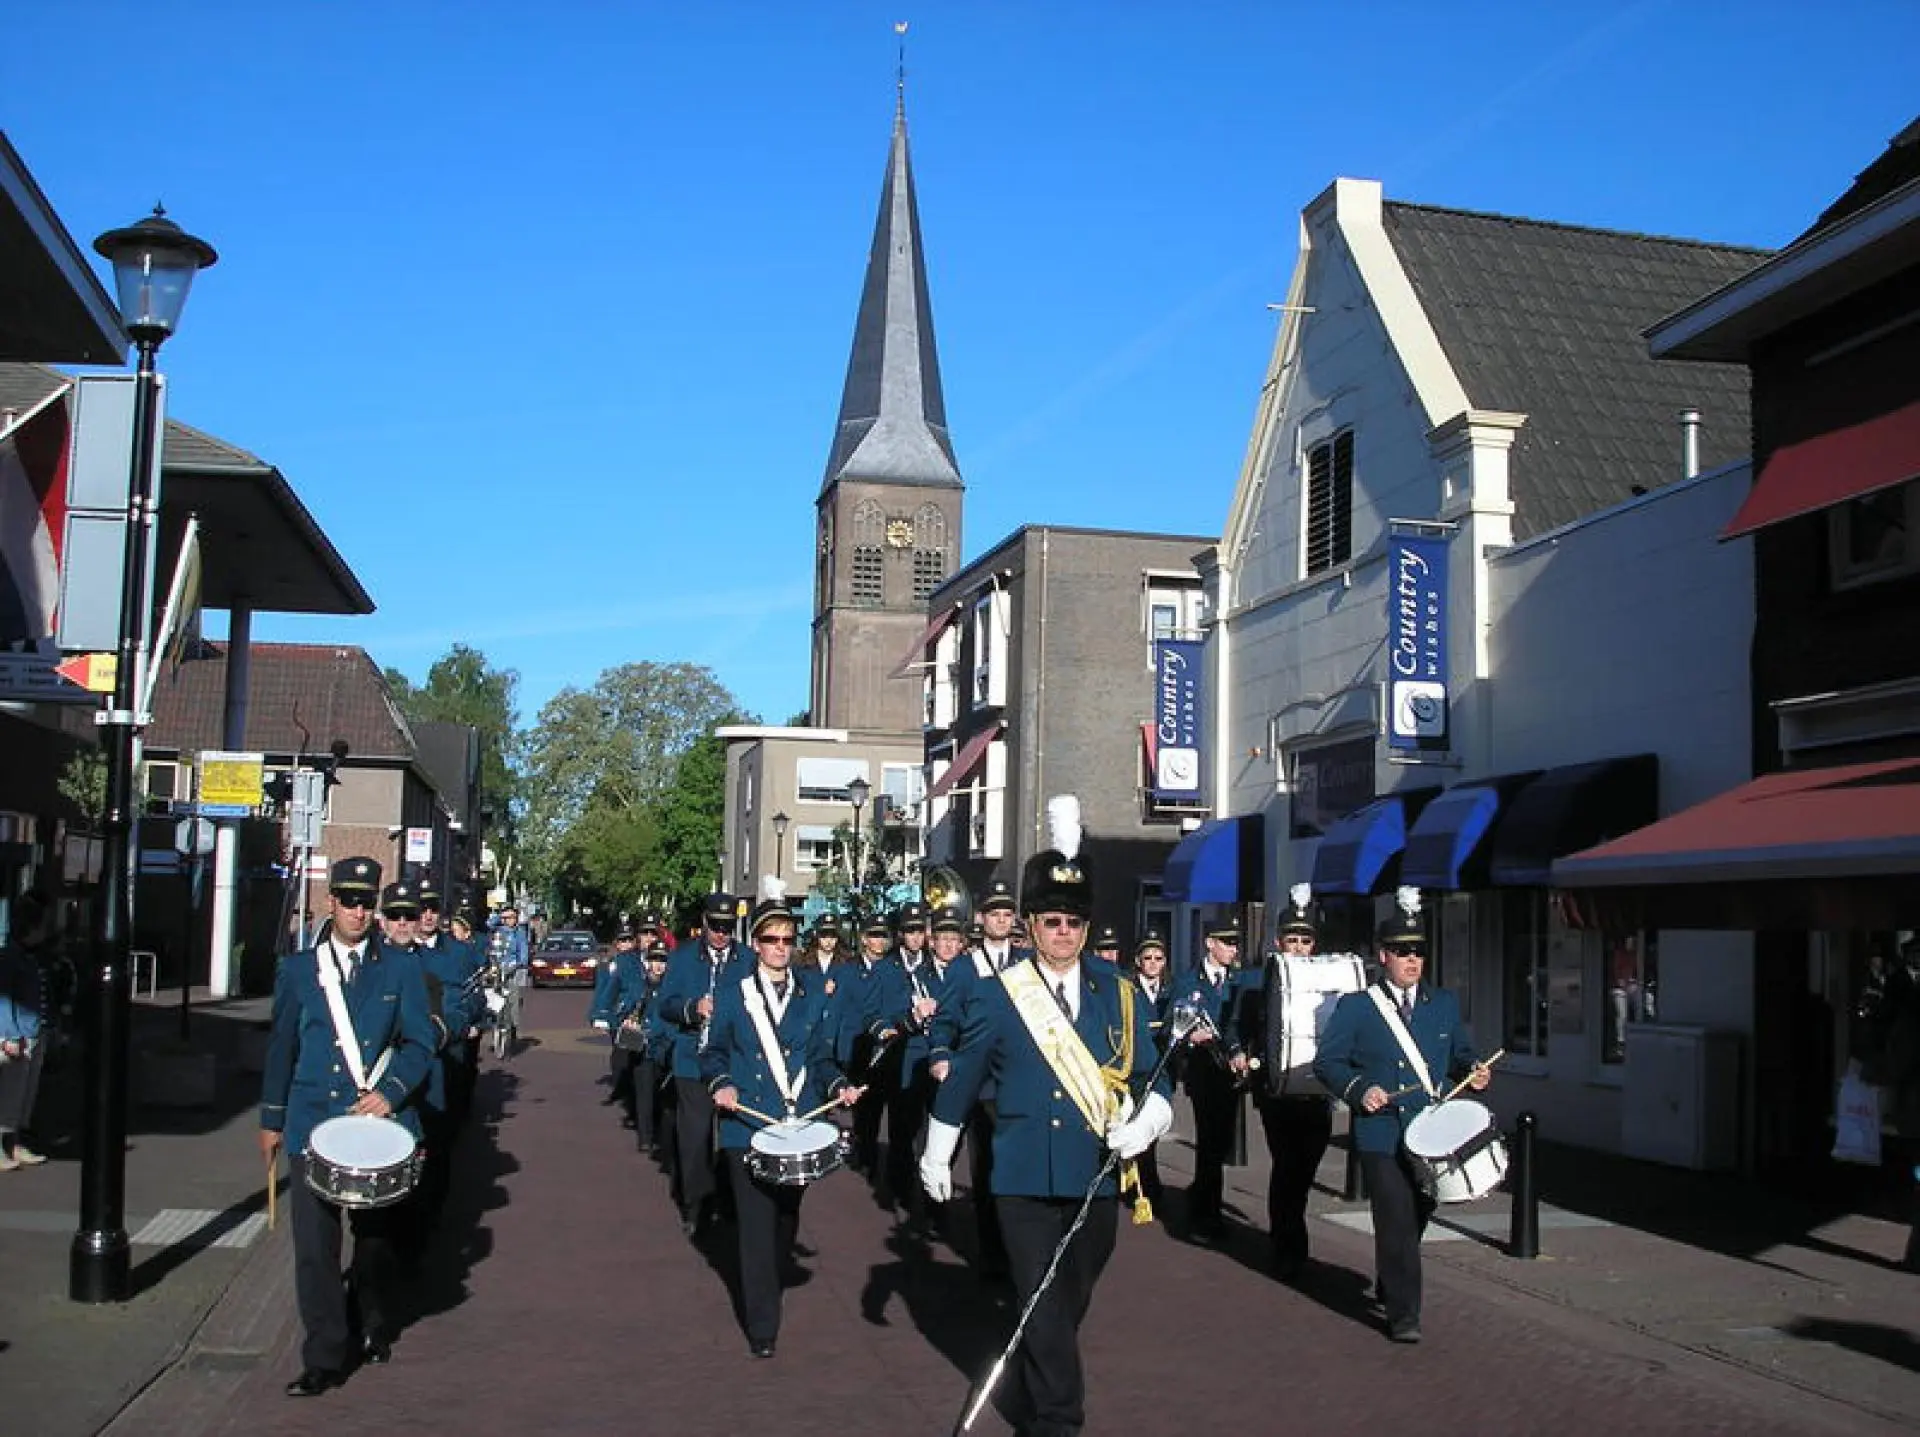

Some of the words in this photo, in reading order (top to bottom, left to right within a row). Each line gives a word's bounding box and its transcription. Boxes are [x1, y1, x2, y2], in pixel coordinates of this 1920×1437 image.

[1393, 548, 1428, 675] Country
[1425, 591, 1438, 675] wishes
[1159, 649, 1186, 745] Country
